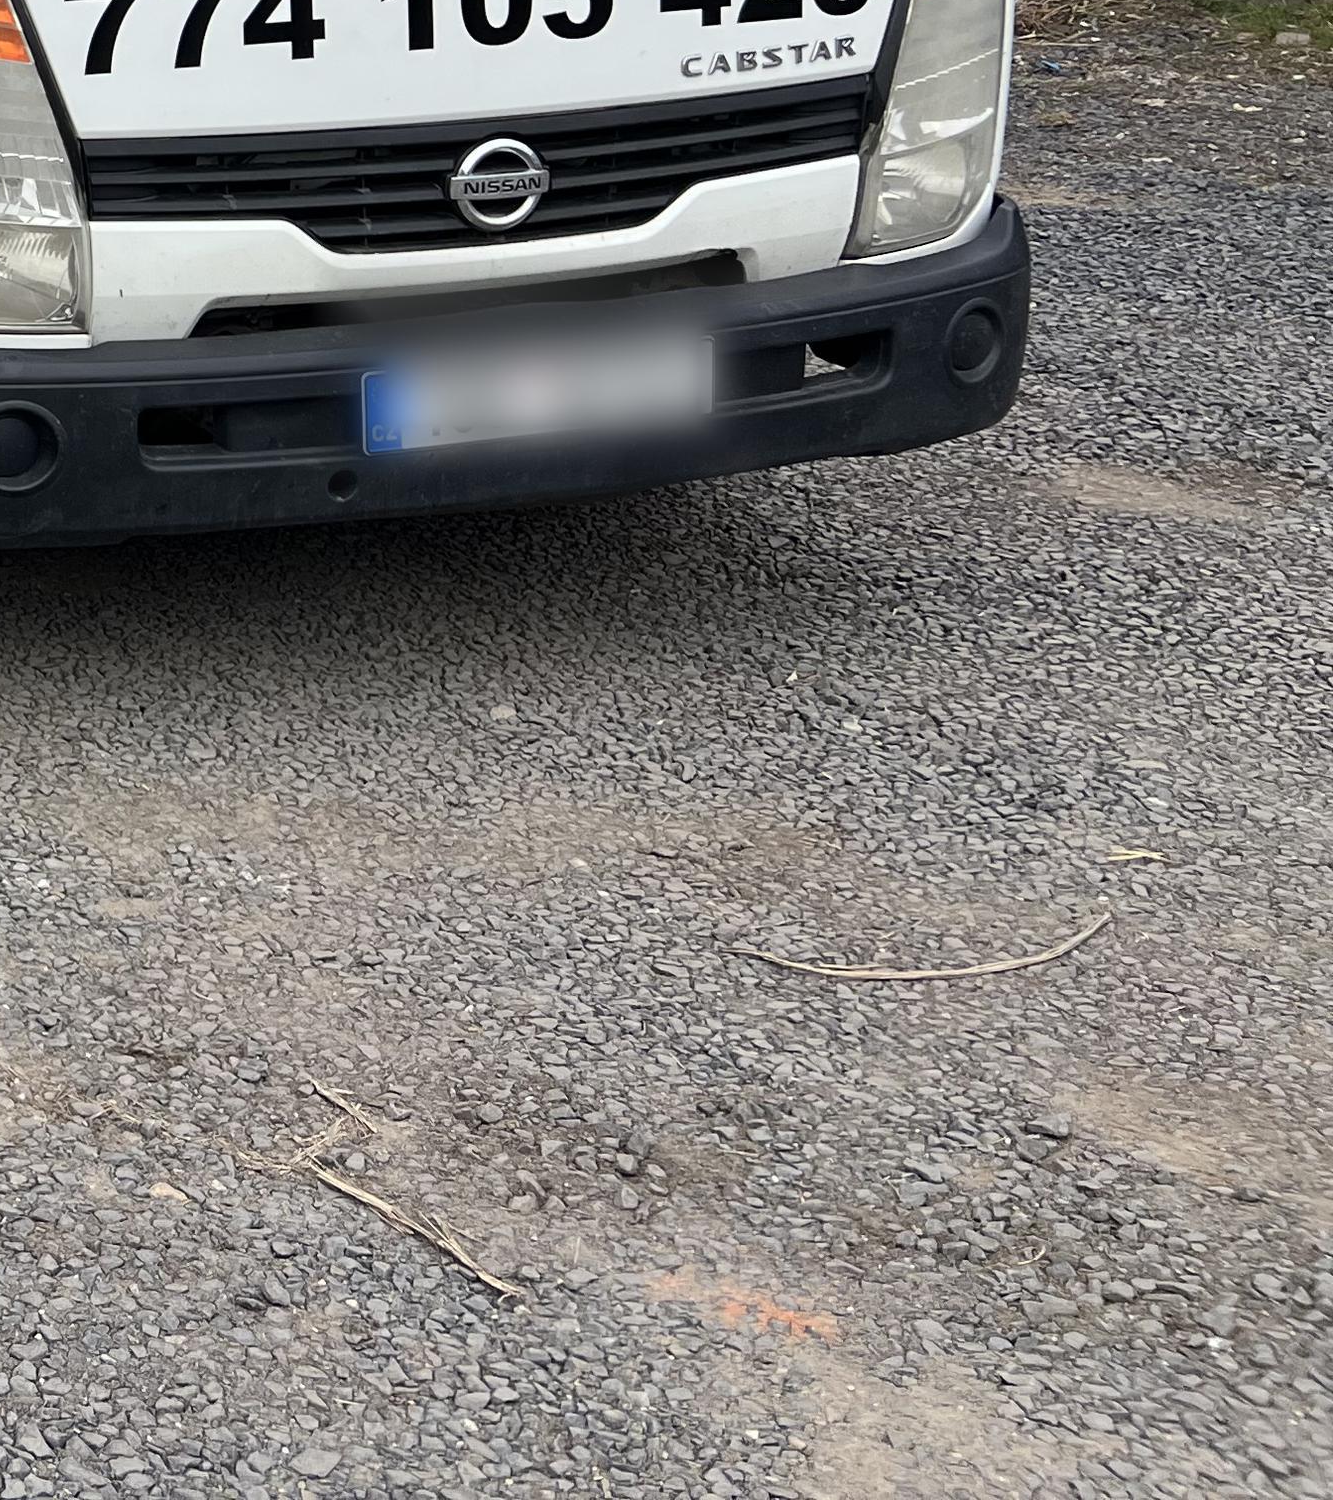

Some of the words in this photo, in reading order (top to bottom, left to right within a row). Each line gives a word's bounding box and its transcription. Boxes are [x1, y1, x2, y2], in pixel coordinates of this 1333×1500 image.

[680, 33, 858, 79] CABSTAR
[463, 176, 541, 195] NISSAN
[371, 423, 398, 443] CZ
